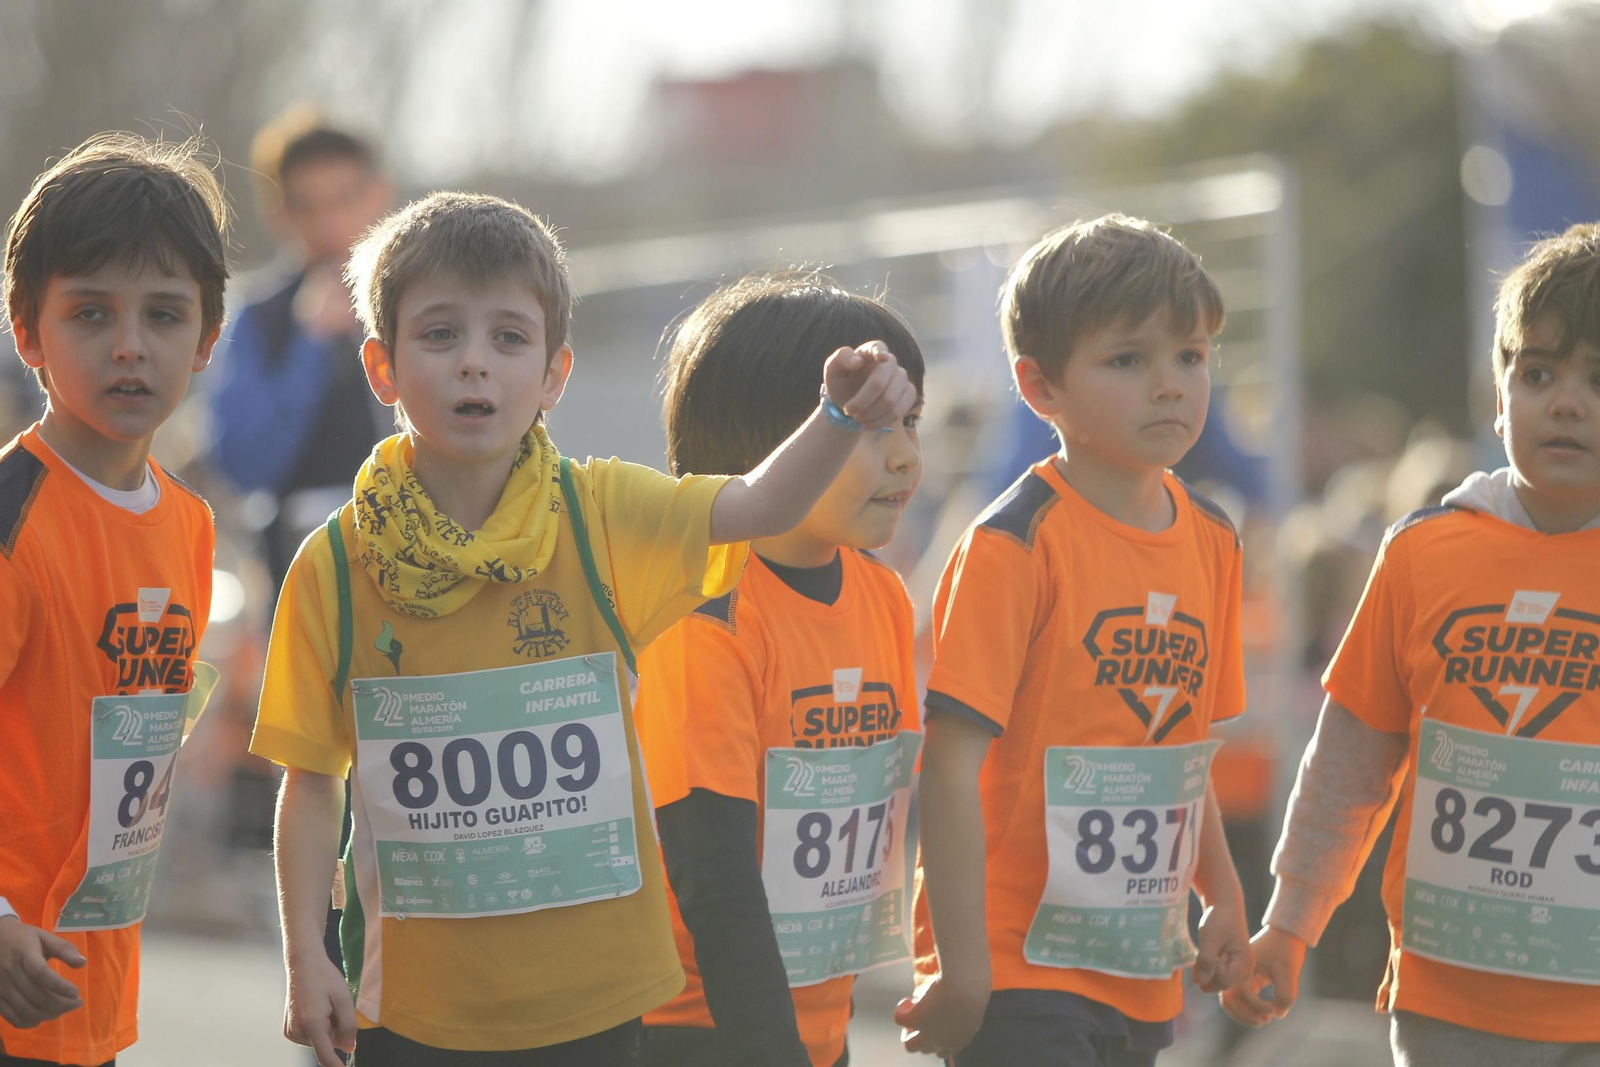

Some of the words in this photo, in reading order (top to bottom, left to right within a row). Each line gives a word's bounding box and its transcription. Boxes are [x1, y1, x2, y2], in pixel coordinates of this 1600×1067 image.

[1460, 626, 1600, 660] SUPER
[519, 671, 599, 695] CARRERA
[409, 692, 445, 703] MEDIO
[525, 690, 602, 714] INFANTIL
[409, 700, 468, 714] MARATÓN
[411, 712, 463, 726] ALMERÍA
[803, 703, 889, 737] SUPER
[411, 725, 454, 734] 03/02/2019
[1459, 744, 1489, 758] MEDIO
[390, 723, 601, 809] 8009
[1103, 763, 1136, 773] MEDIO
[1458, 755, 1506, 772] MARATÓN
[1103, 772, 1151, 784] MARATÓN
[1456, 766, 1499, 783] ALMERÍA
[1102, 784, 1146, 795] ALMERÍA
[408, 810, 478, 831] HIJITO
[485, 795, 588, 825] GUAPITO!
[453, 833, 476, 841] DAVID
[477, 829, 502, 839] LOPEZ
[504, 824, 545, 836] BLAZQUEZ
[472, 845, 511, 856] ALMERÍA
[1126, 877, 1179, 895] PEPITO
[1490, 867, 1533, 889] ROD
